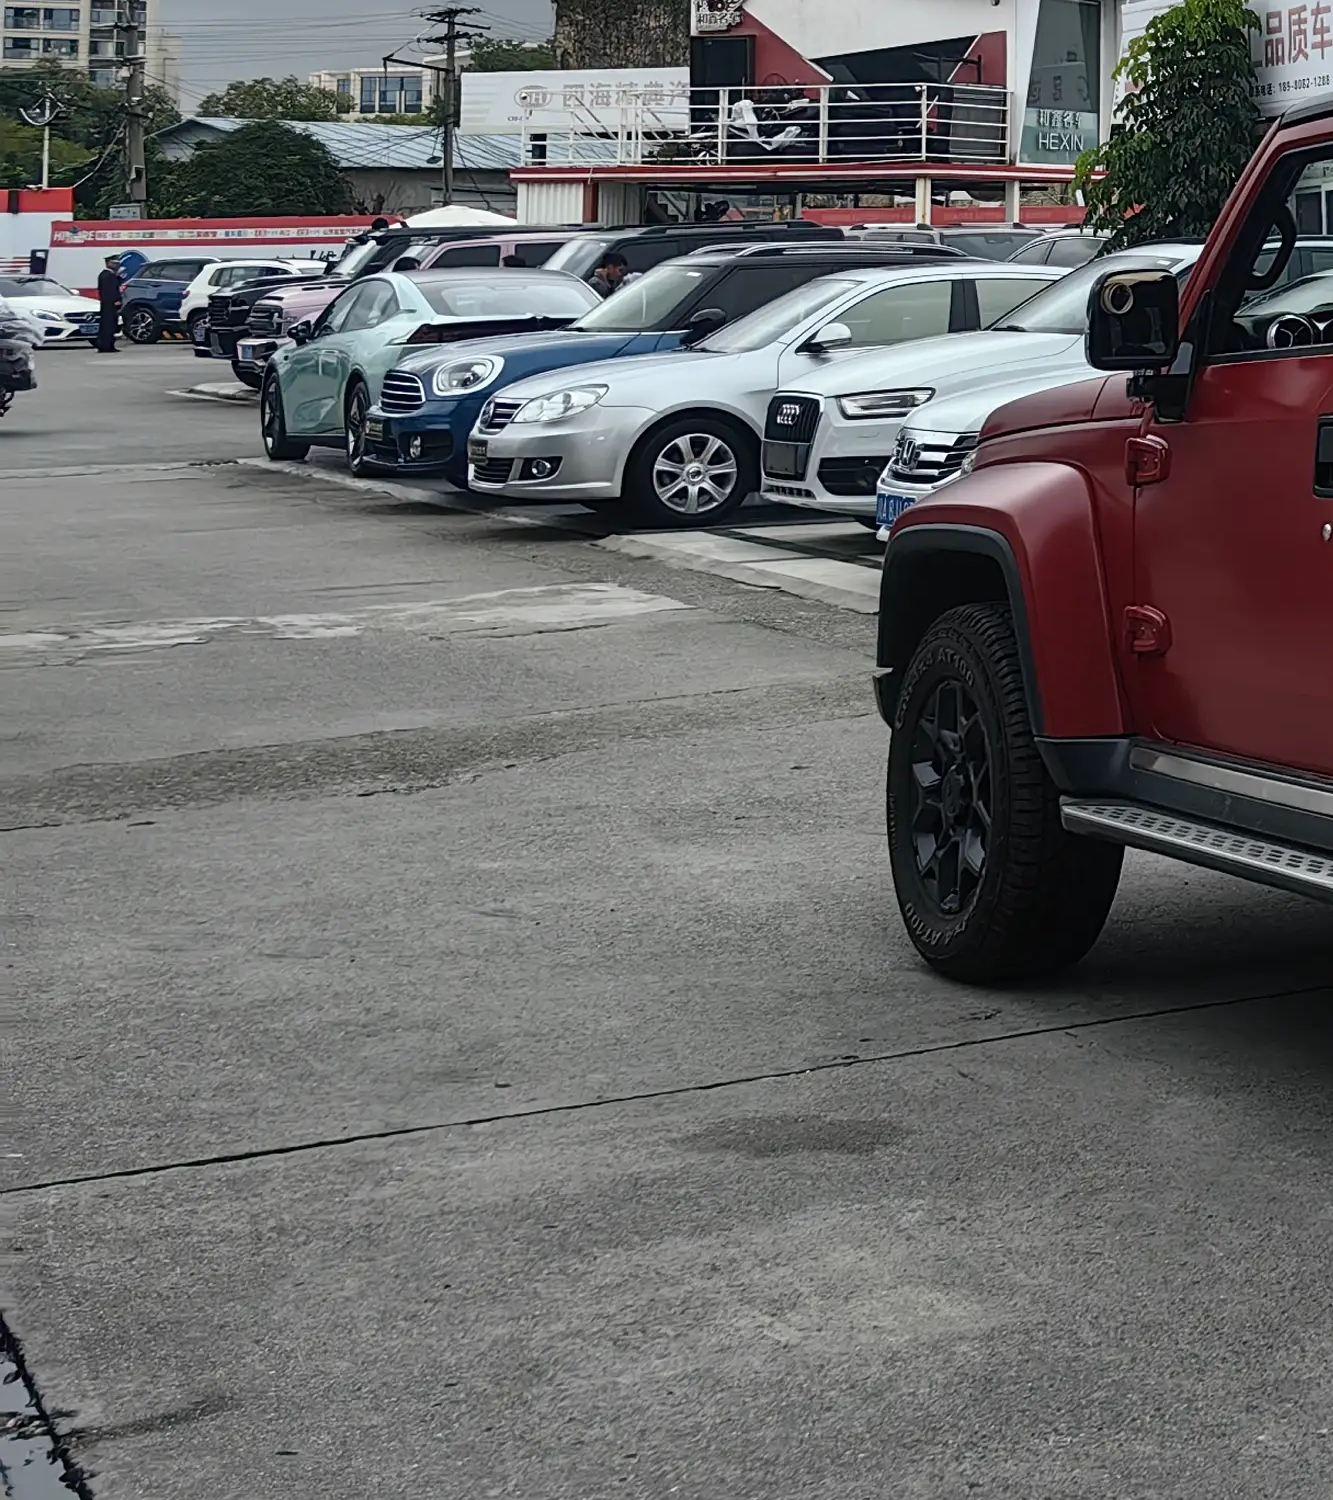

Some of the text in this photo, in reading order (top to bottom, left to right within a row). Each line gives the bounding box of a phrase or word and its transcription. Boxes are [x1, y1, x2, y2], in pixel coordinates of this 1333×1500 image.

[1252, 1, 1333, 68] 品质车
[1039, 132, 1084, 151] HEXIN
